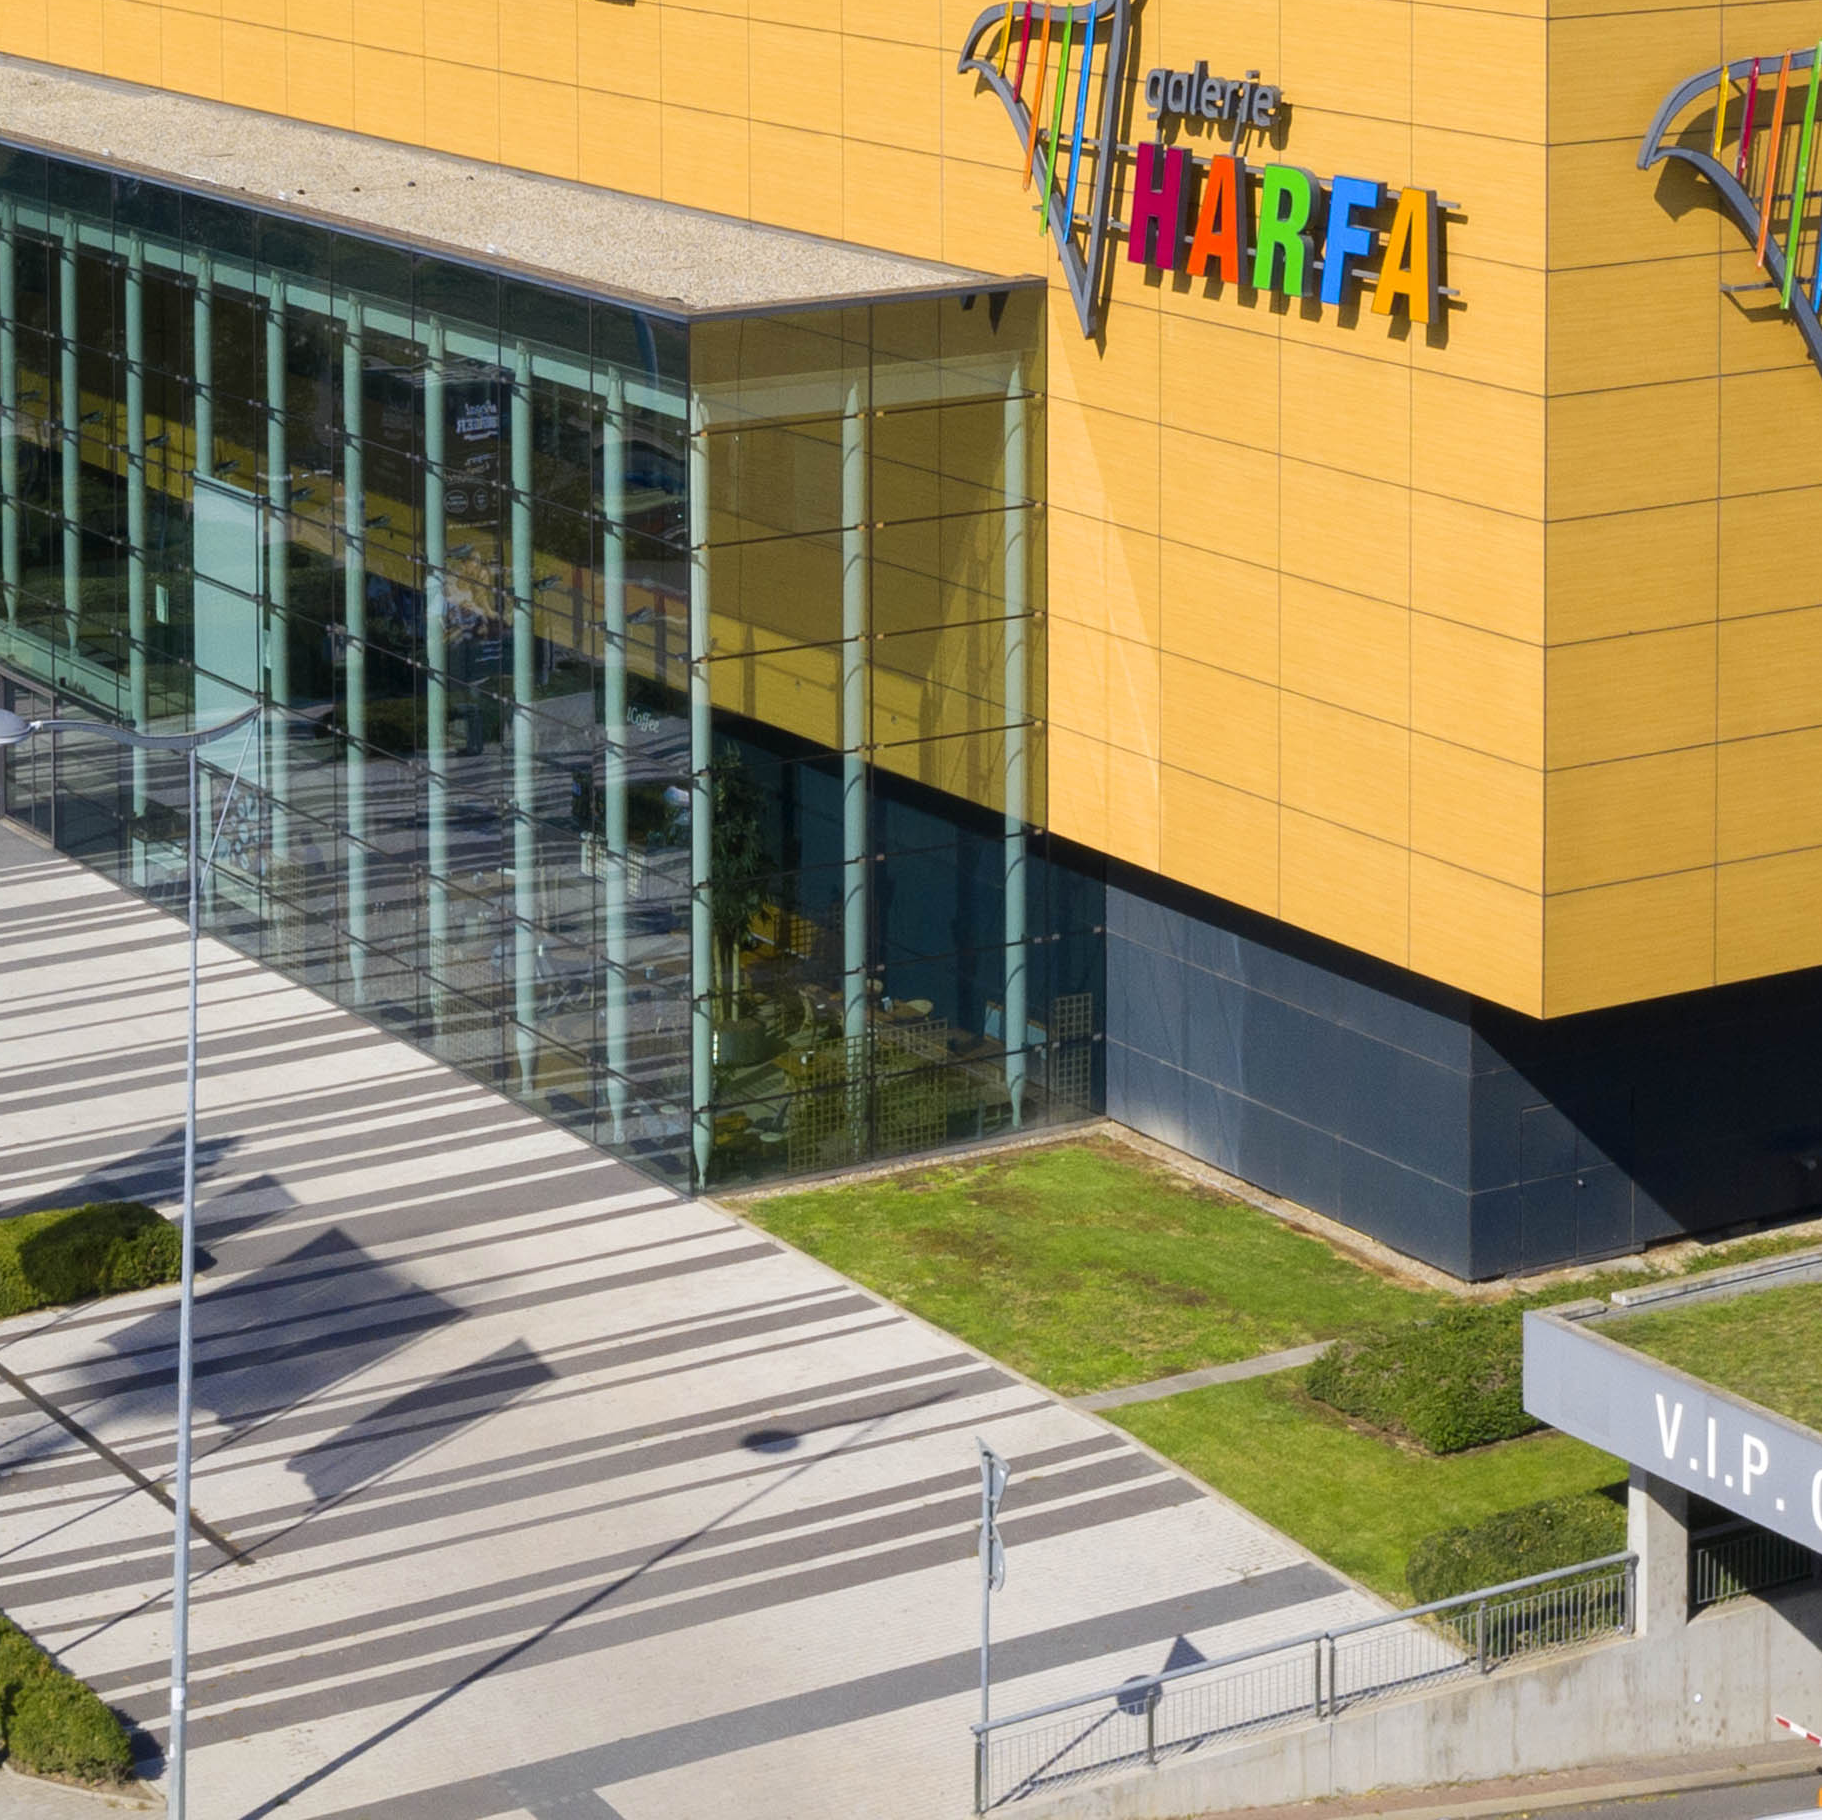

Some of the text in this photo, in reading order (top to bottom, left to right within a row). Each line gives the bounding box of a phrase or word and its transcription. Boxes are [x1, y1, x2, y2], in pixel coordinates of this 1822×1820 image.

[1144, 60, 1281, 127] galerie
[1127, 141, 1437, 326] HARFA
[1654, 1392, 1786, 1512] V.I.P.
